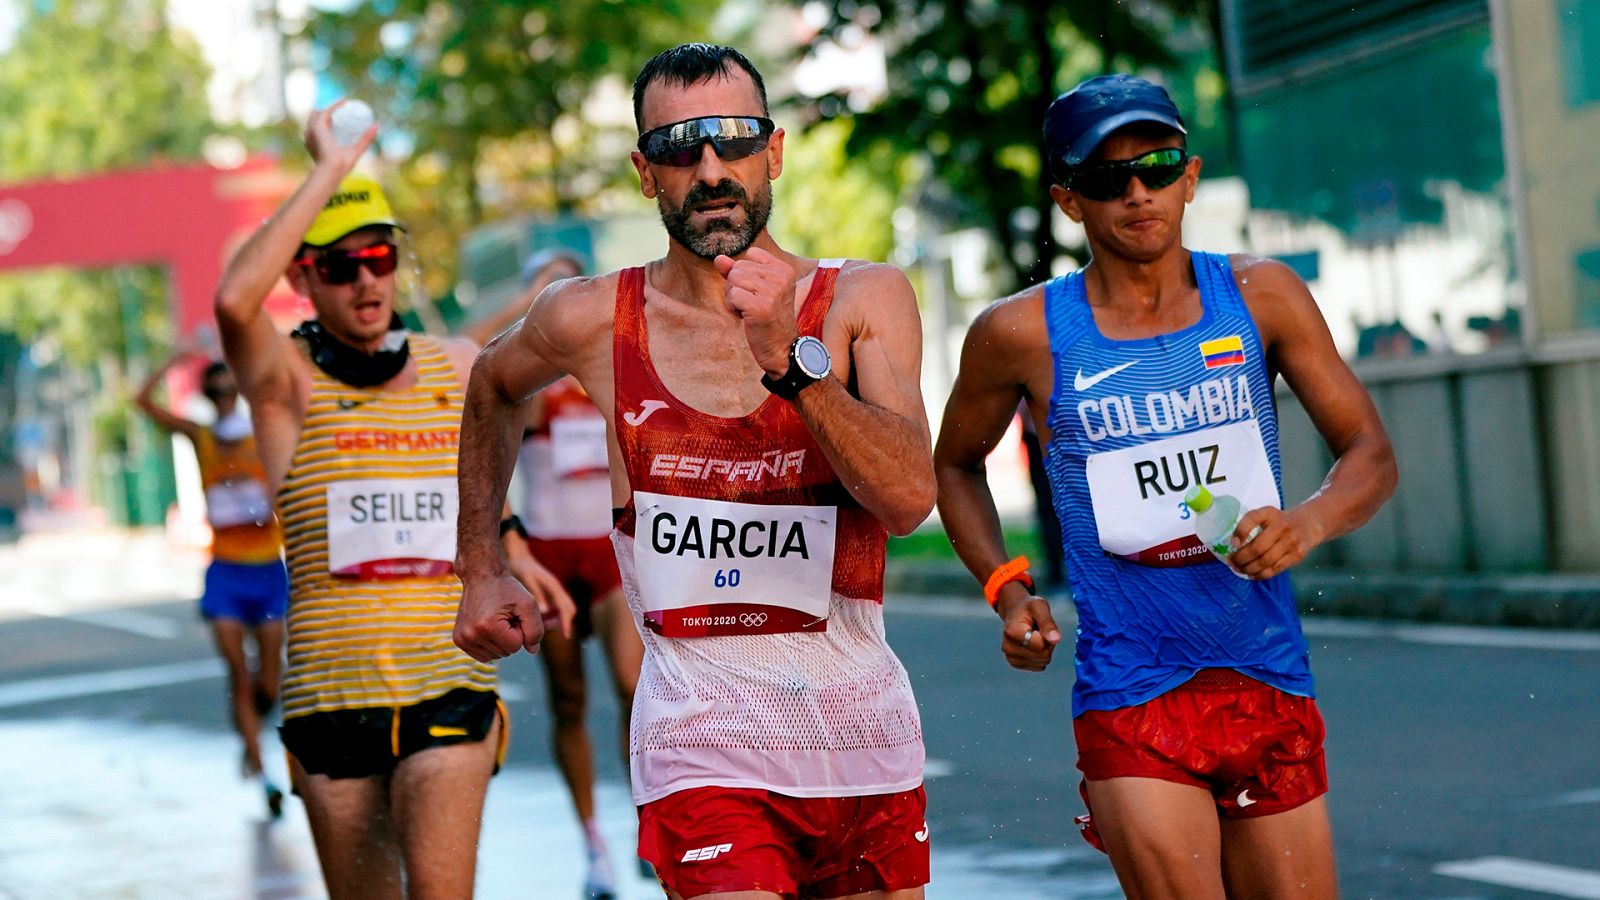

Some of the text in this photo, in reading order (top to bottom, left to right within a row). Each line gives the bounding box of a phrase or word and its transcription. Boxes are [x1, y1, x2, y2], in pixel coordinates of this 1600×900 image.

[1077, 374, 1256, 442] COLOMBIA
[650, 449, 806, 482] ESPAÑA
[1134, 444, 1227, 500] RUIZ
[350, 492, 445, 524] SEILER
[395, 531, 411, 544] 81
[651, 512, 809, 560] GARCIA
[1158, 544, 1208, 561] TOKYO 2020
[713, 568, 741, 588] 60
[682, 615, 736, 627] TOKYO 2020
[680, 843, 733, 863] ESP
